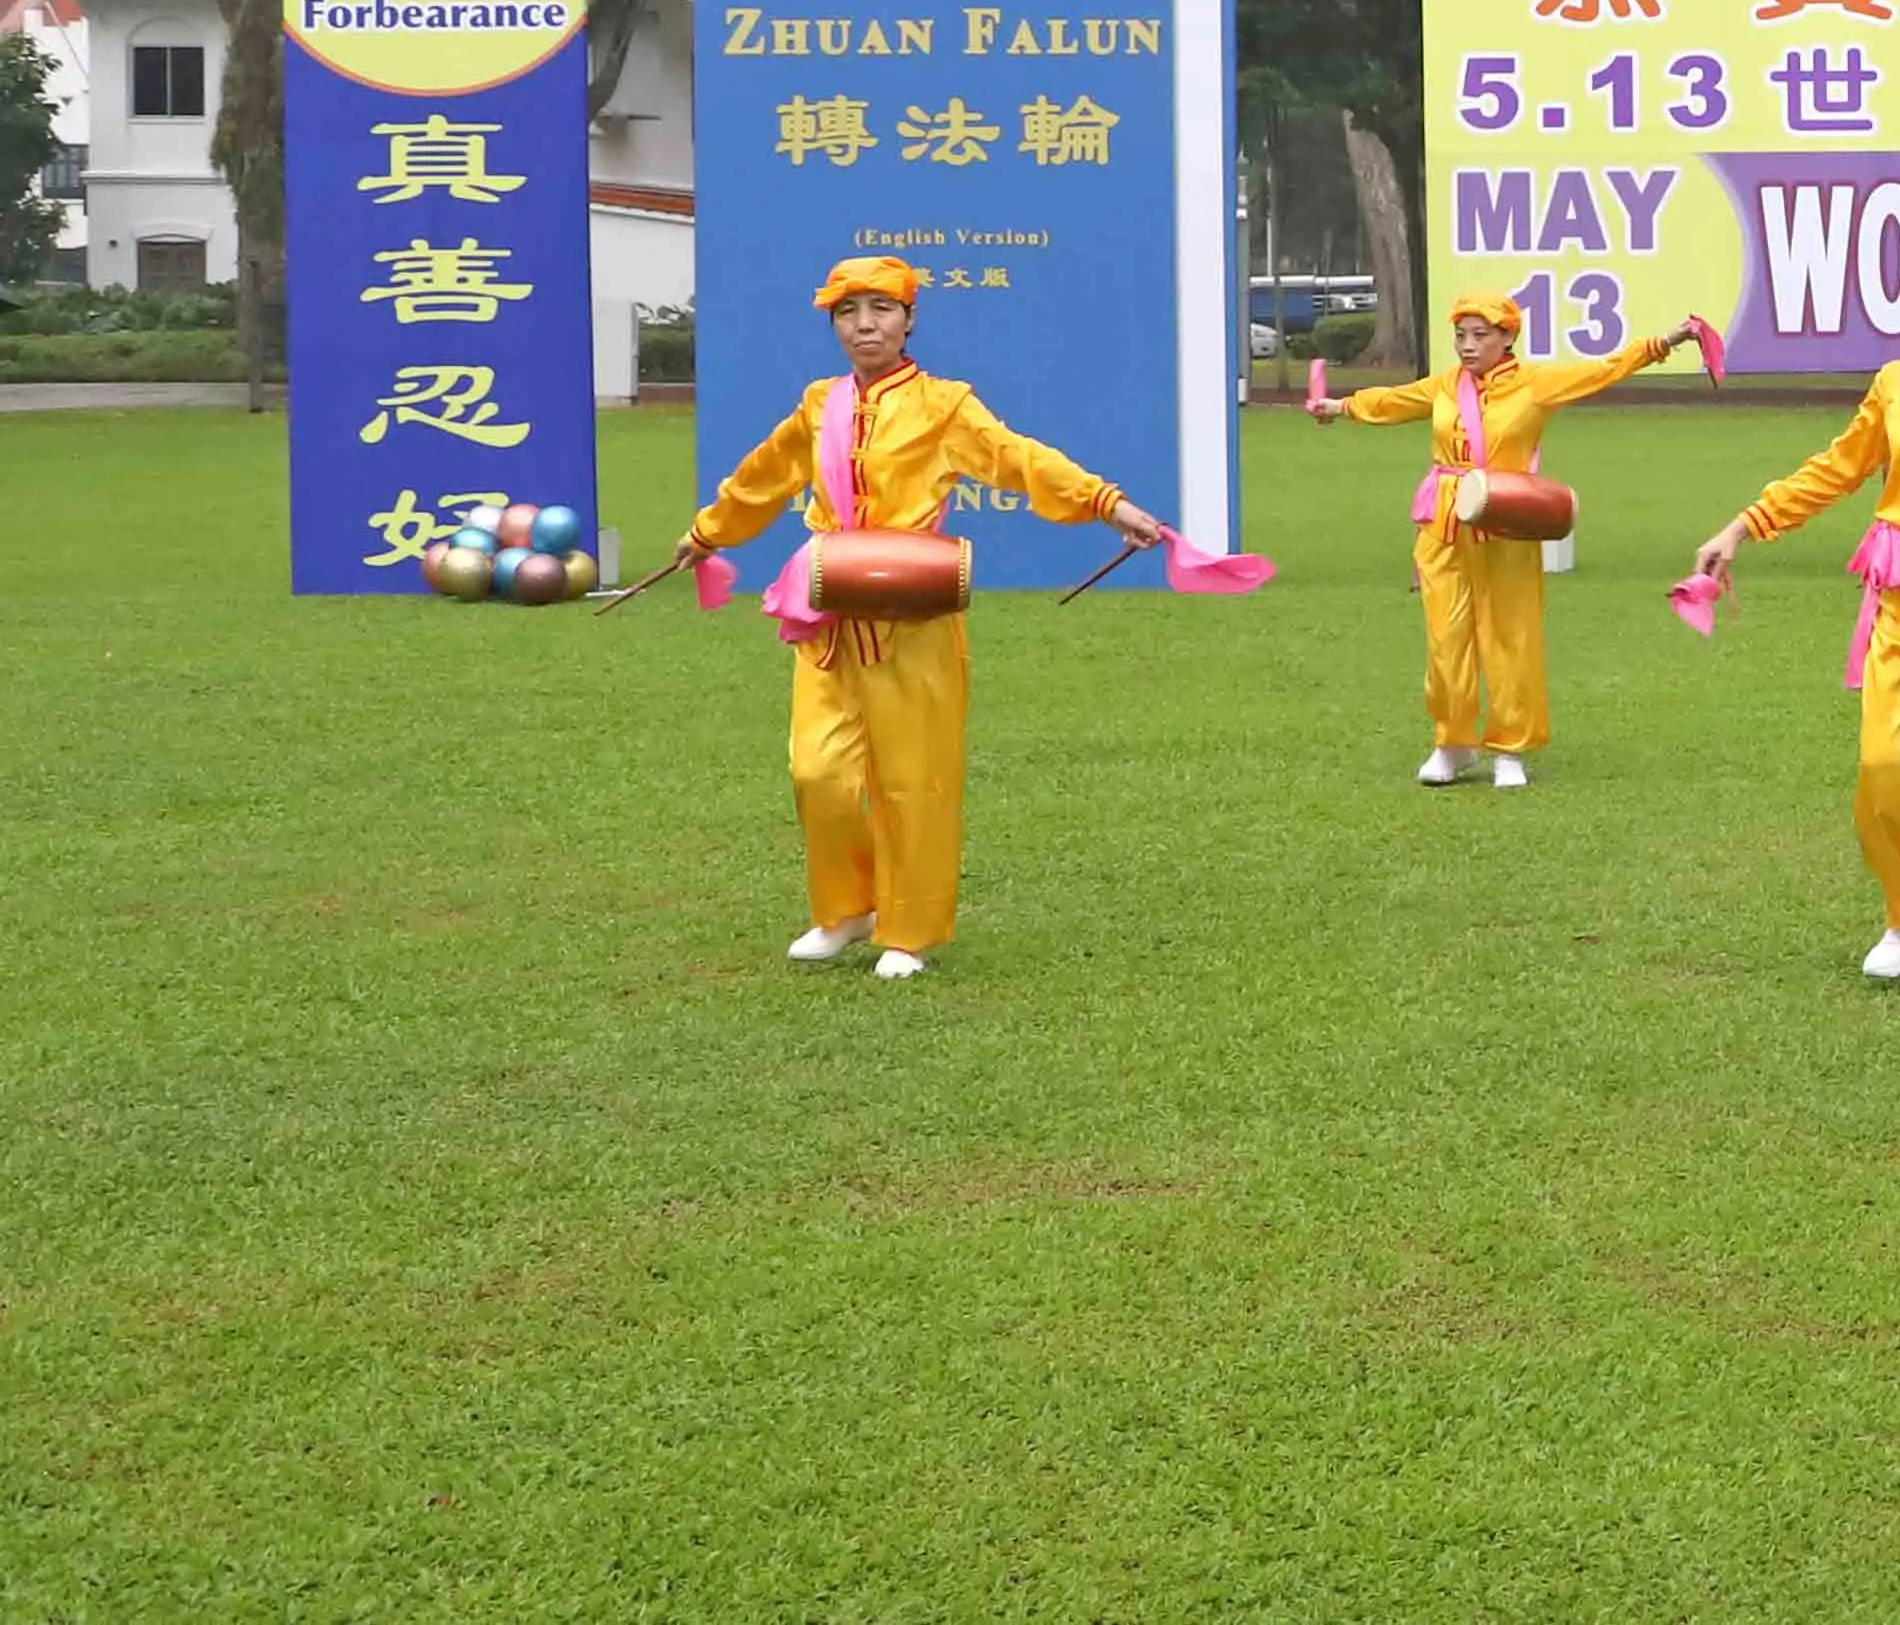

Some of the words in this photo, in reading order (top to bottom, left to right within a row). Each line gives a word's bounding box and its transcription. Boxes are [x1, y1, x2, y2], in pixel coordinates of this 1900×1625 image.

[723, 7, 933, 56] ZHUAN
[964, 7, 1161, 56] FALUN
[774, 93, 1120, 166] 轉法輪
[855, 228, 946, 249] (English
[956, 228, 1050, 249] Version)
[1456, 170, 1675, 252] MAY
[1512, 273, 1624, 357] 13
